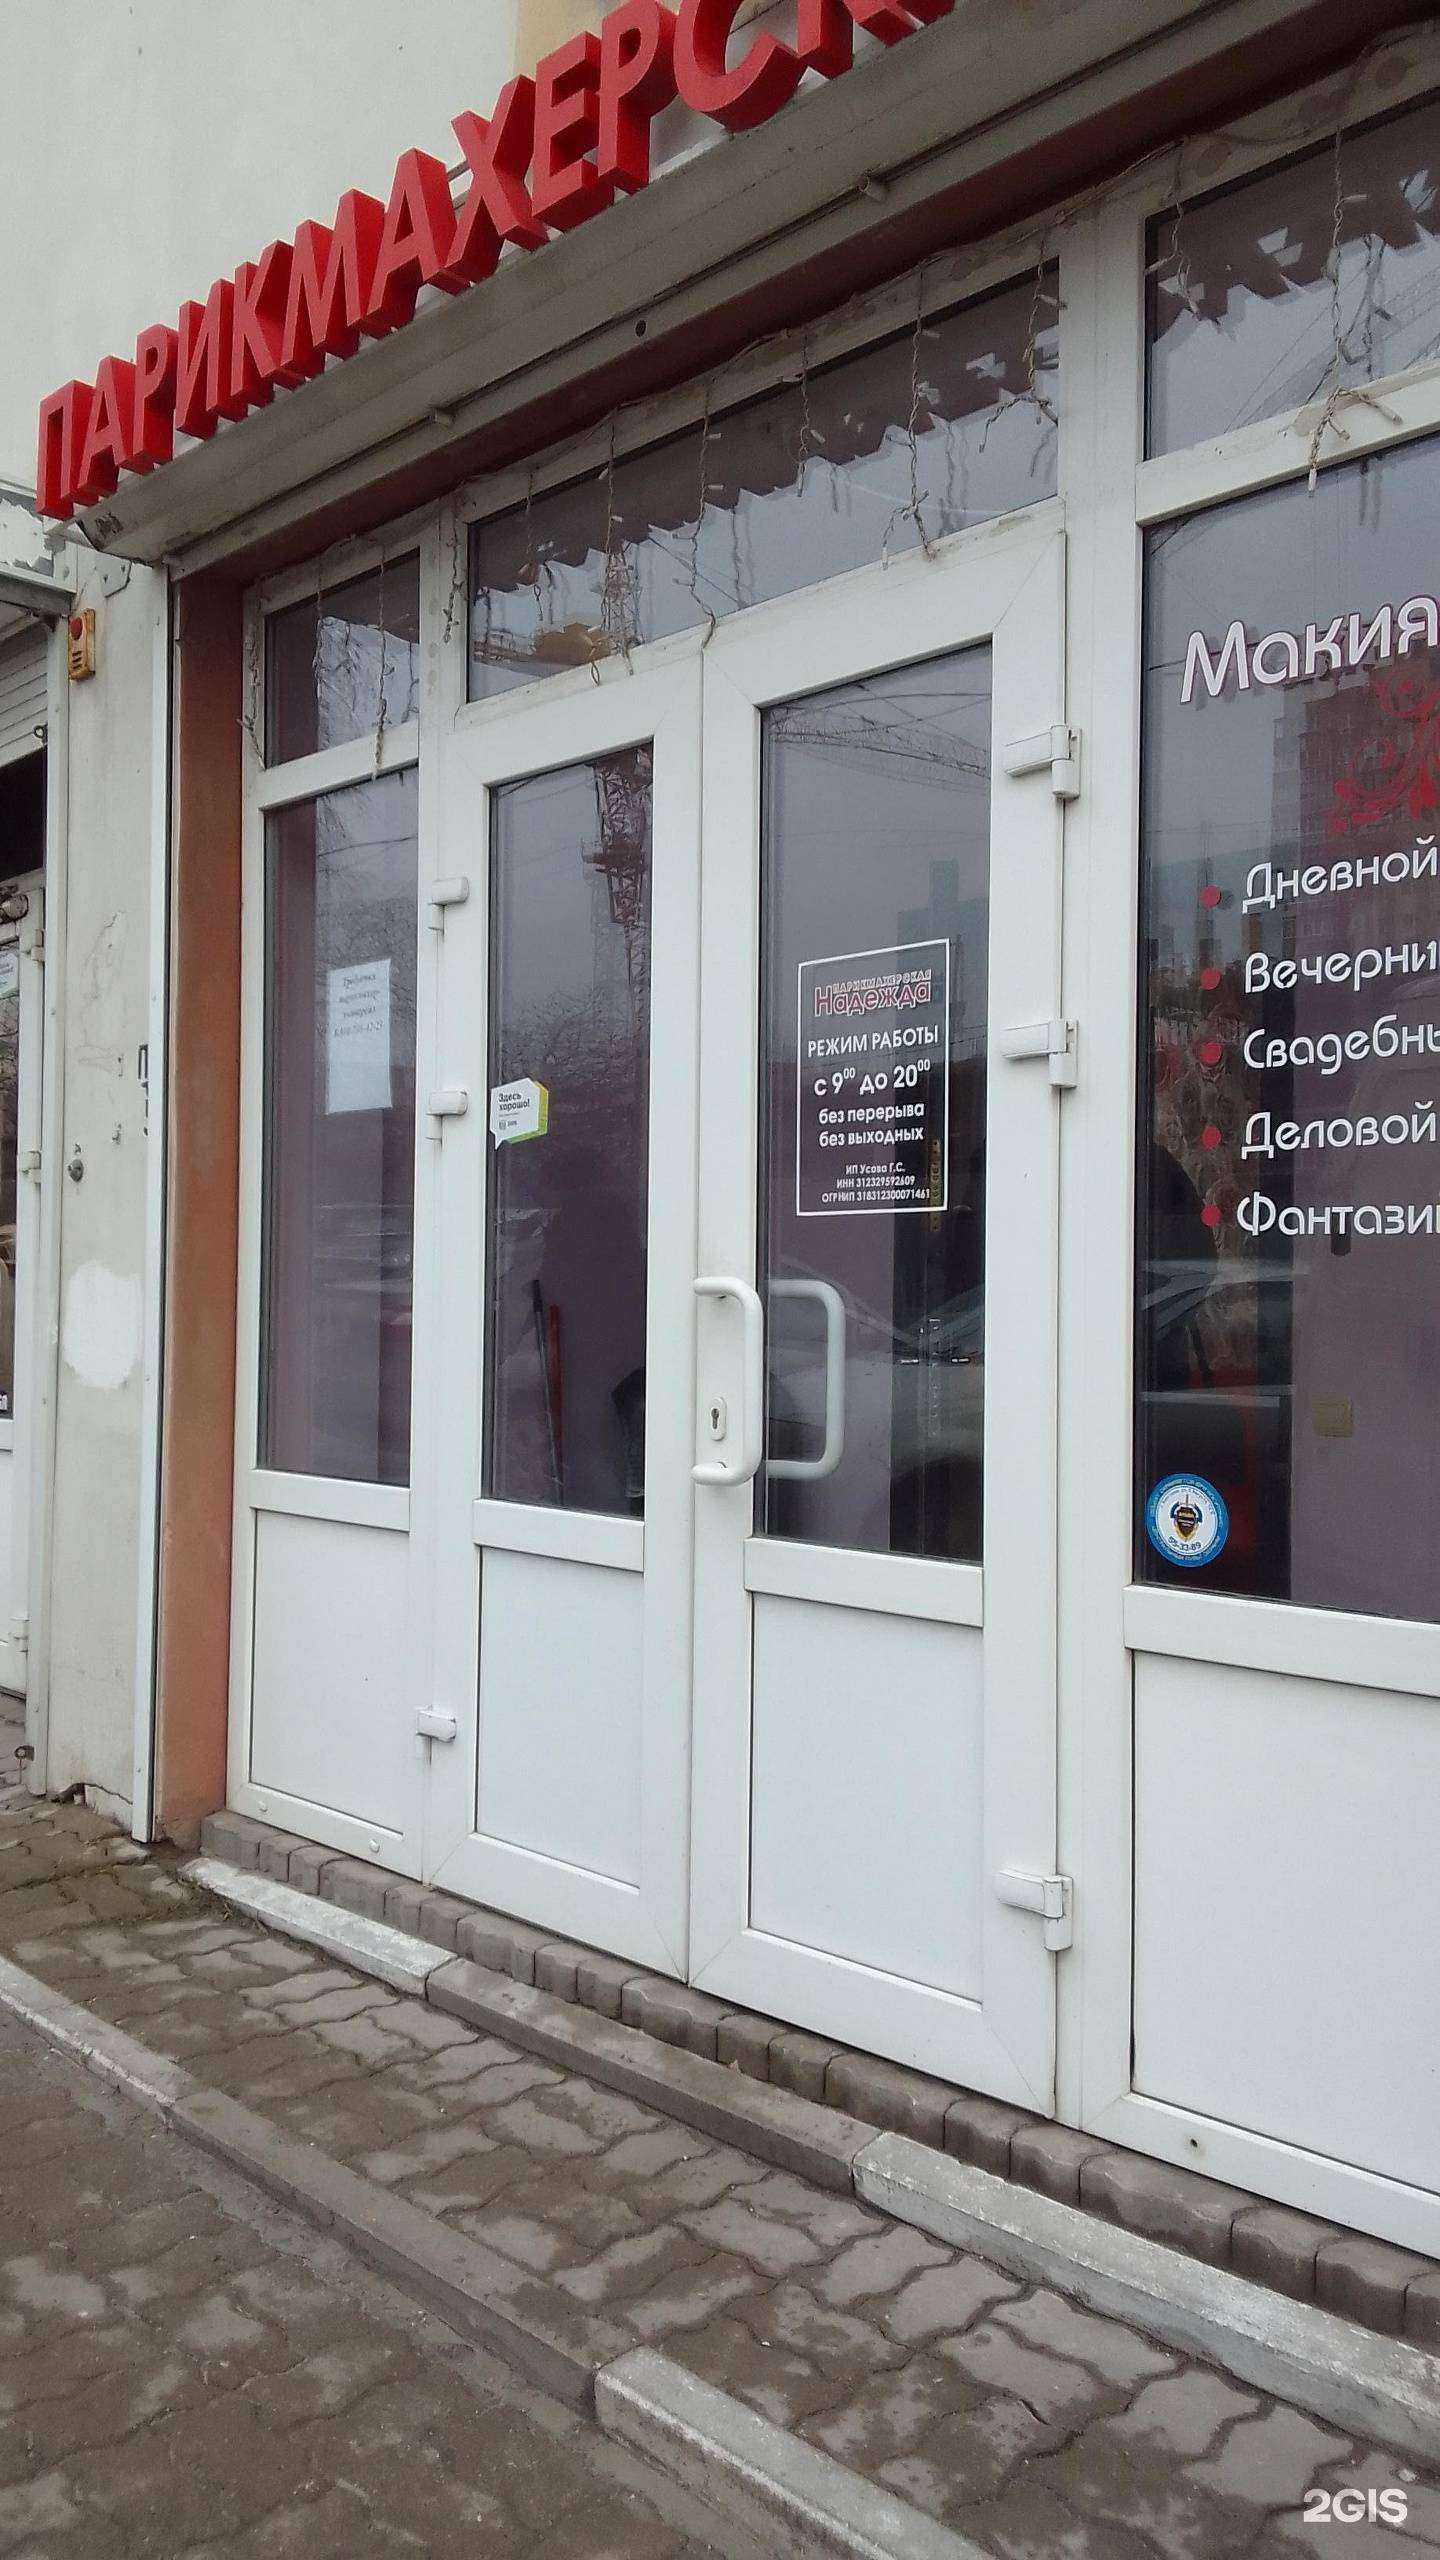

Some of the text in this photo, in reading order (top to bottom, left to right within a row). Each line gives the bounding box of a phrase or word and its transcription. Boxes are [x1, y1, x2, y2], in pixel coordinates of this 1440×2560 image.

[36, 0, 954, 521] ПАРИКМАХЕРС
[1180, 596, 1440, 704] Макия
[1242, 834, 1438, 915] Дневной
[833, 969, 931, 994] ПАРИКМАХЕРСКАЯ
[815, 981, 931, 1017] Надежда
[808, 1025, 938, 1058] РЕЖИМ РАБОТЫ
[860, 1073, 888, 1095] до
[819, 1103, 925, 1124] без перерыва
[819, 1127, 924, 1147] без выходных
[1241, 1101, 1436, 1160] Деловой
[836, 1175, 916, 1189] ИНН 312329592609
[845, 1161, 906, 1175] ИП Усова Г.С.
[821, 1191, 855, 1203] ОГРНИП
[1237, 1191, 1440, 1237] Фантази
